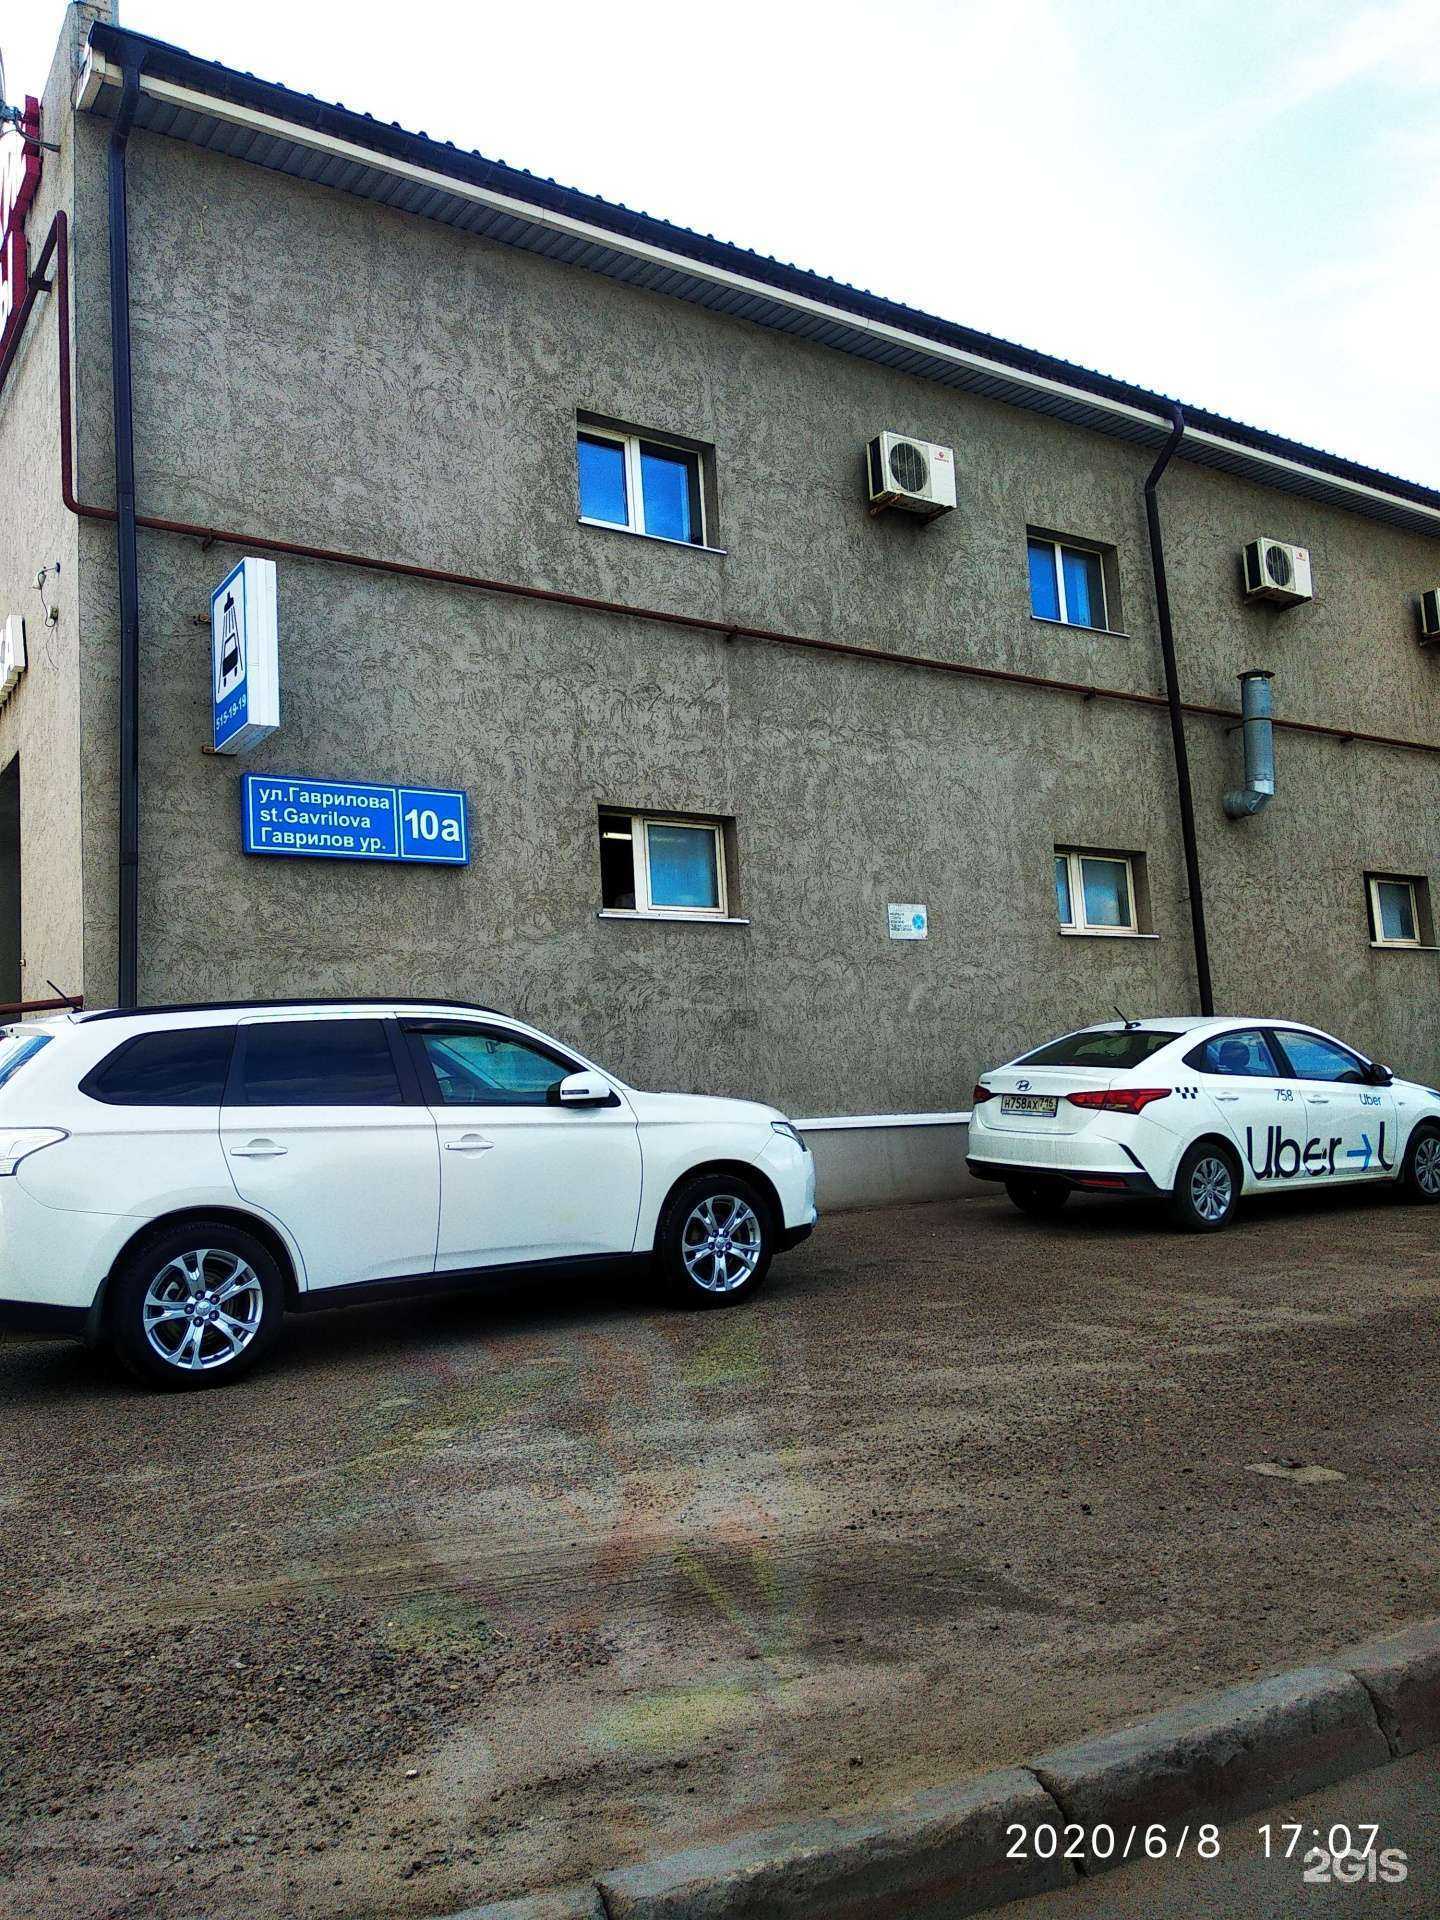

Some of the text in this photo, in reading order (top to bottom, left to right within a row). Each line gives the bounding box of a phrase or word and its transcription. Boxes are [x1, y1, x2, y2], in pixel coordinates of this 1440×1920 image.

[259, 787, 390, 810] ул.Гаврилова
[260, 808, 371, 828] st.Gavrilova
[404, 808, 460, 842] 10а
[261, 827, 387, 852] Гаврилов ур.
[1274, 1089, 1294, 1101] 758
[1359, 1093, 1382, 1106] Uber
[1246, 1125, 1342, 1180] Uber
